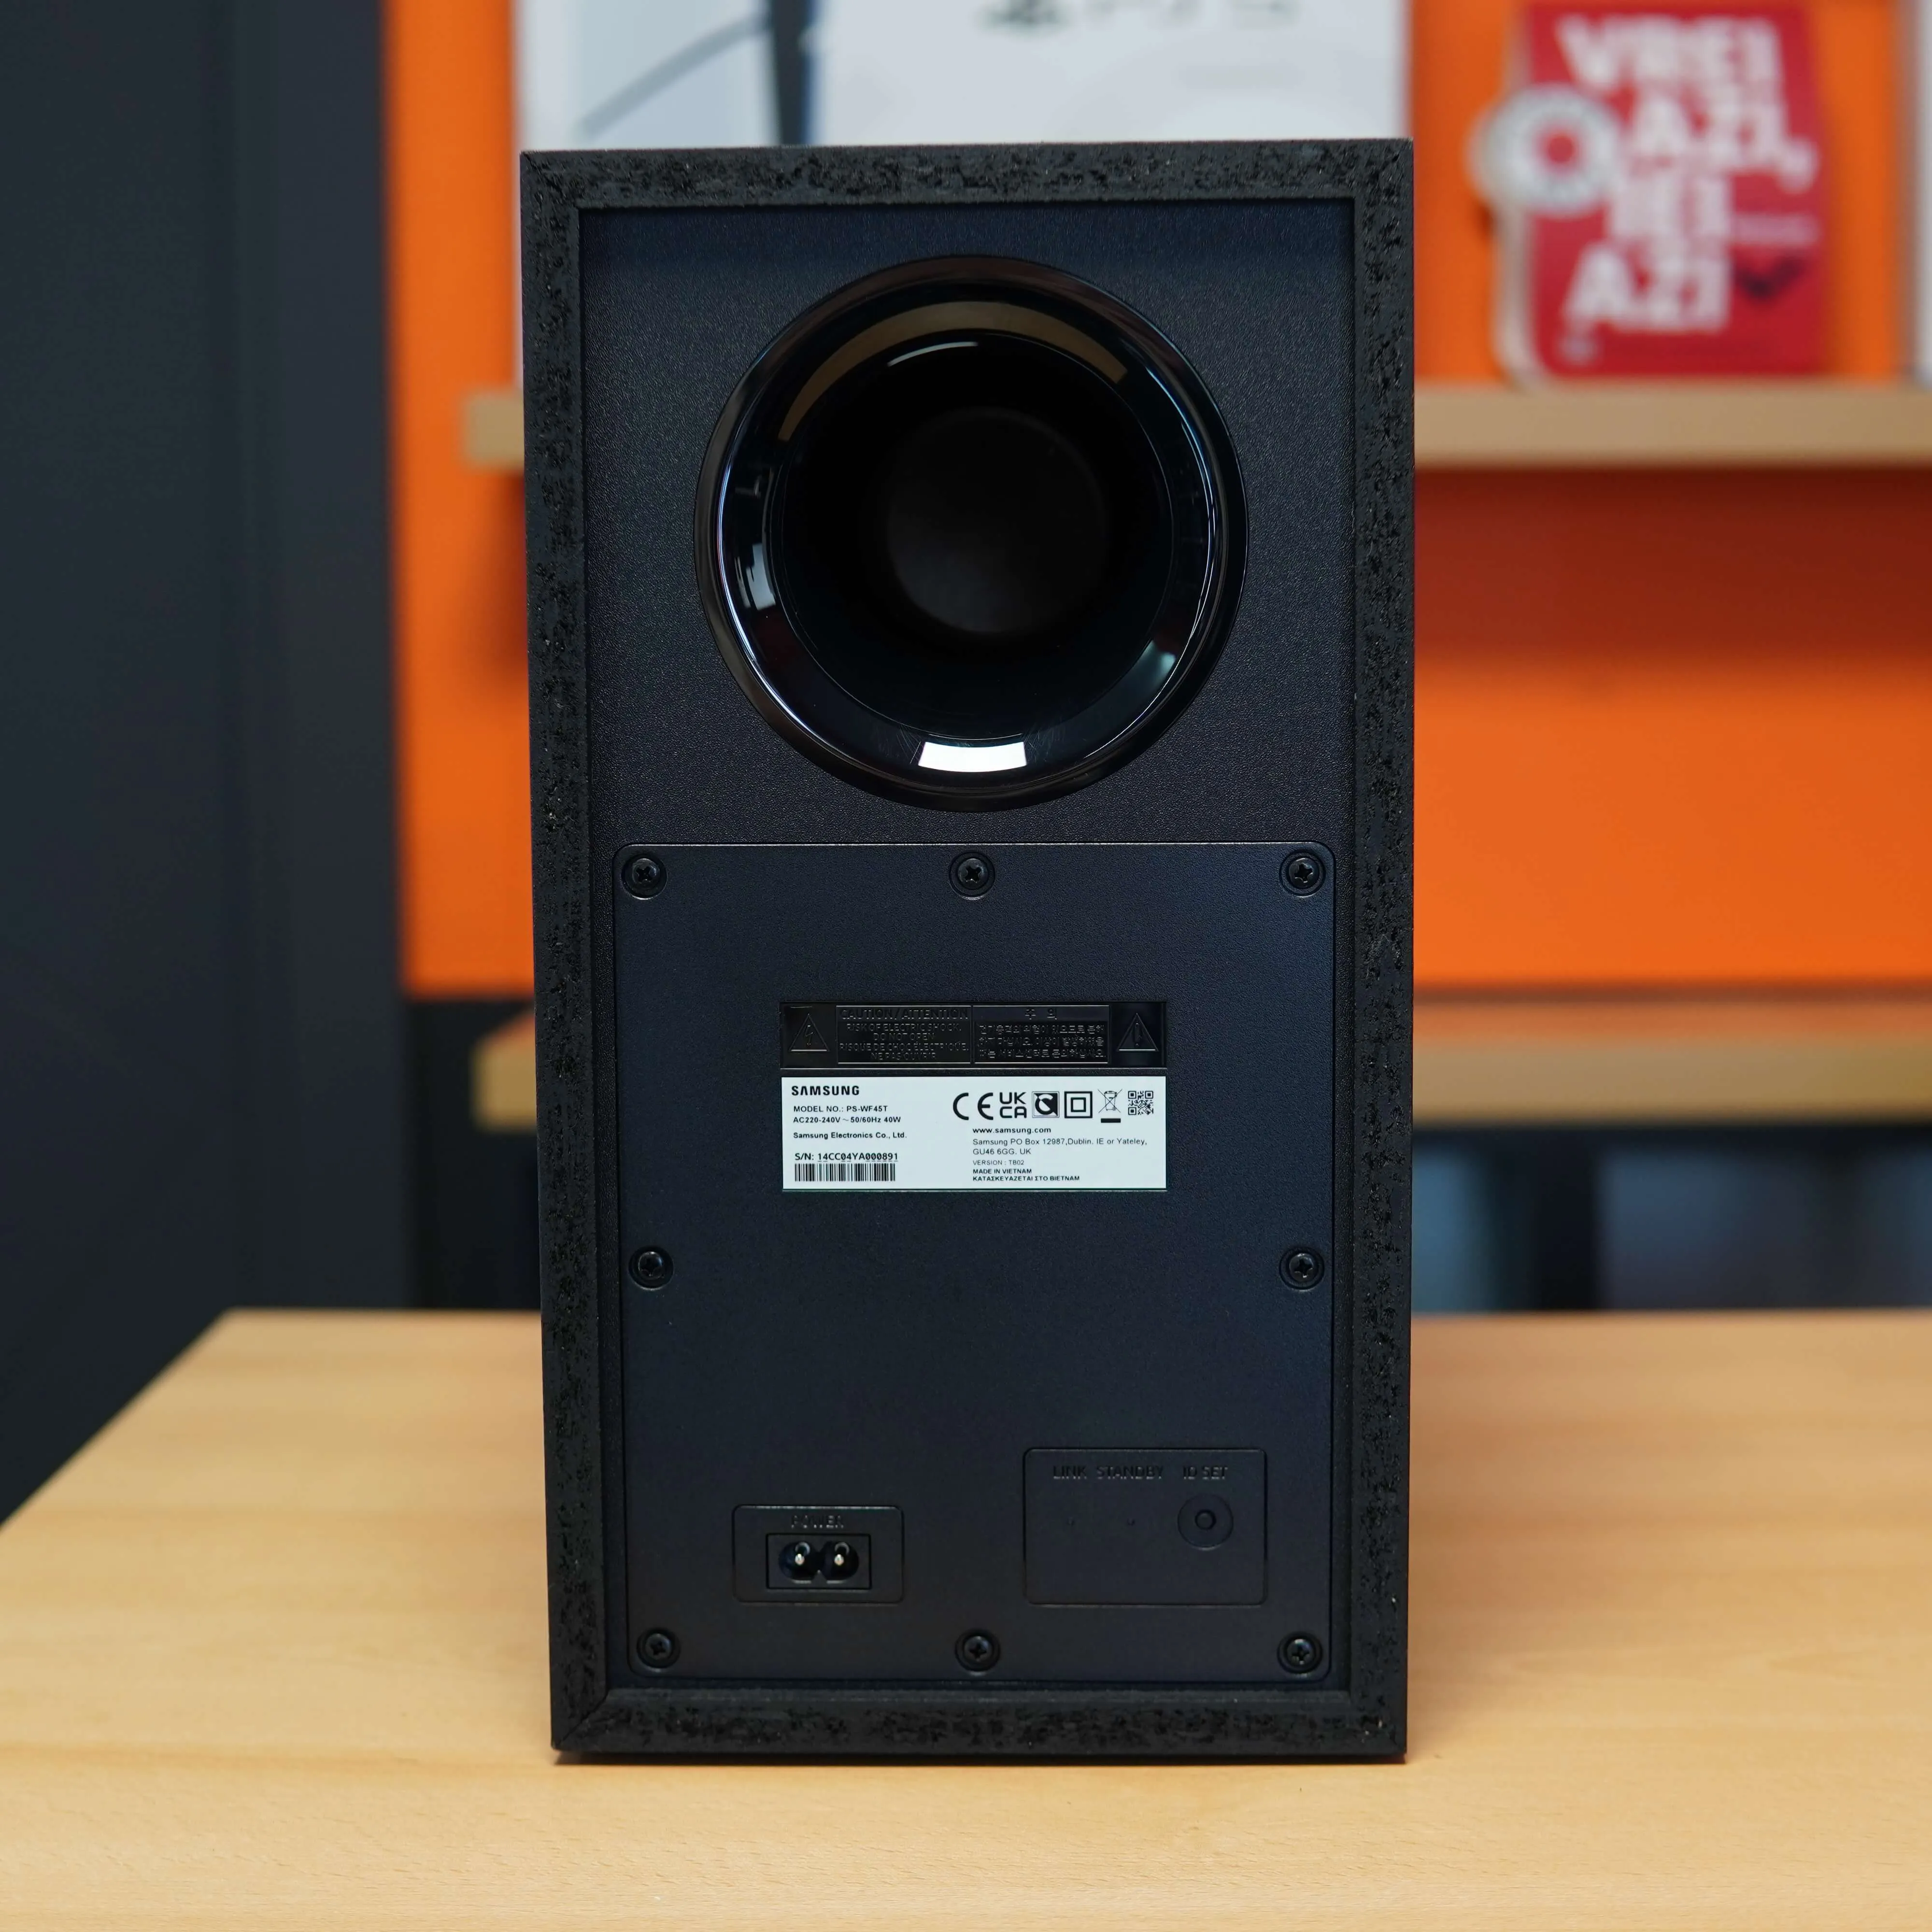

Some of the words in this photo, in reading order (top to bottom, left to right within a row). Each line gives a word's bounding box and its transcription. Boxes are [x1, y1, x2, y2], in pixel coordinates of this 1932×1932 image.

[841, 1009, 891, 1020] CAUTION
[903, 1009, 968, 1020] ATTENTION
[792, 1085, 860, 1096] SAMSUNG
[999, 1092, 1027, 1105] UK
[999, 1106, 1027, 1119] CA
[1052, 1465, 1088, 1480] LINK
[1096, 1465, 1164, 1480] STANDBY
[1202, 1465, 1229, 1481] SET
[791, 1515, 844, 1529] POWER
